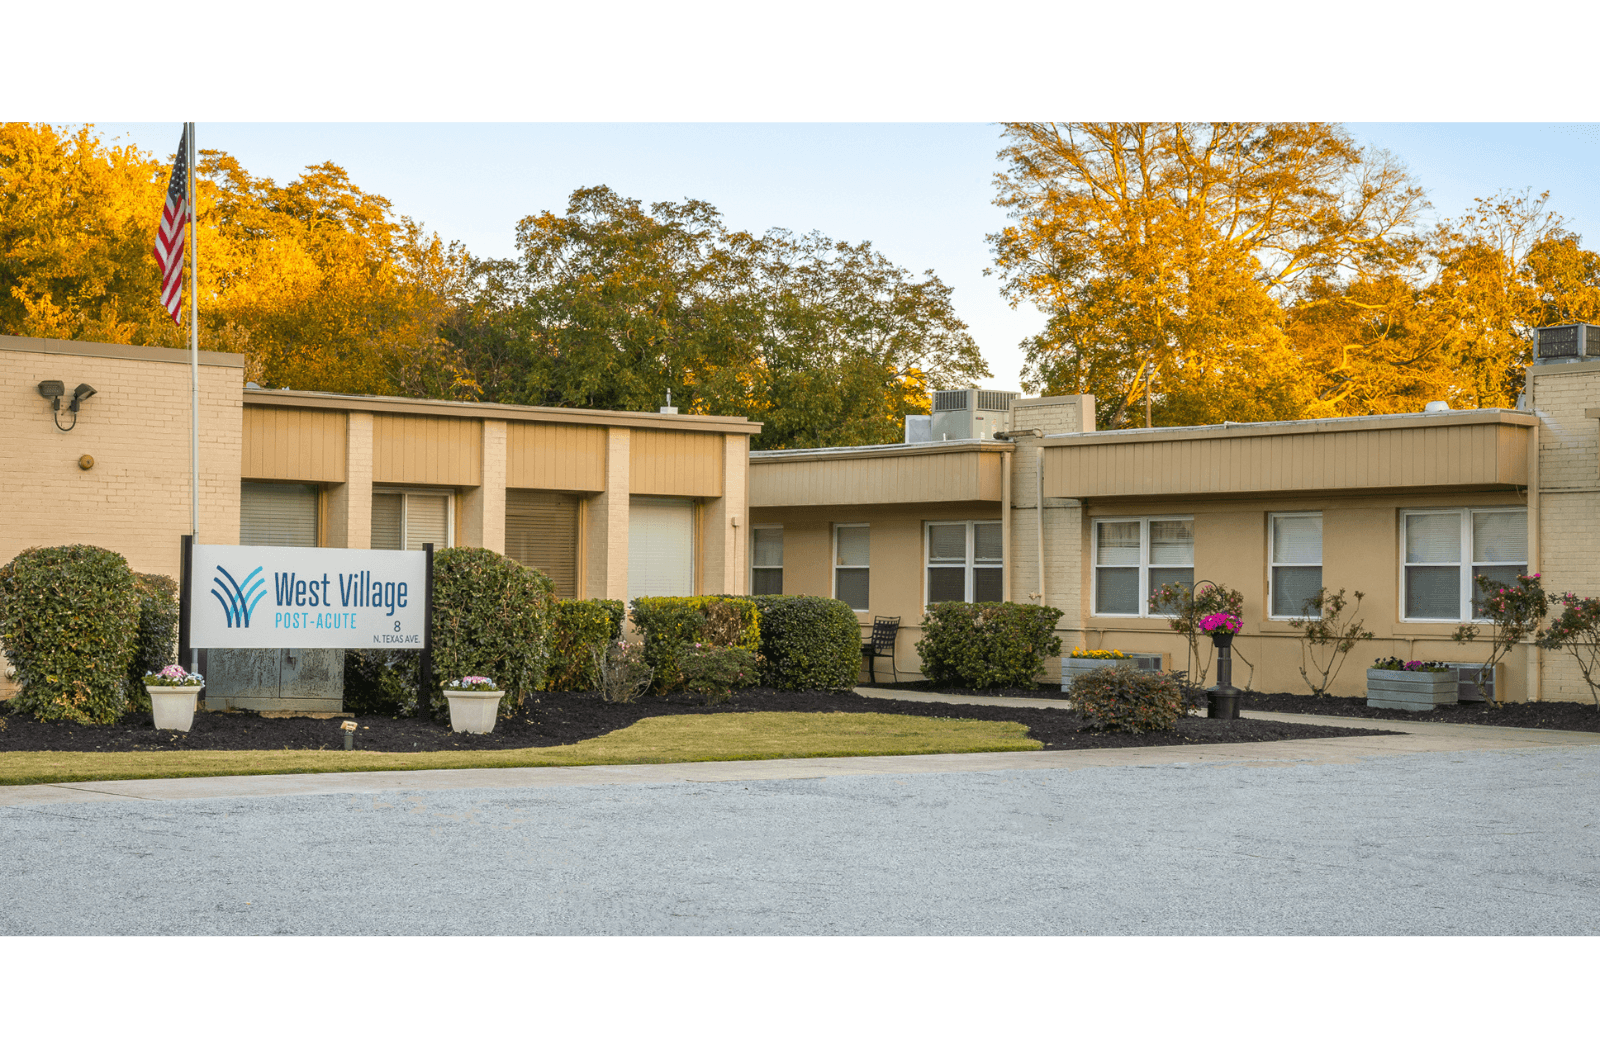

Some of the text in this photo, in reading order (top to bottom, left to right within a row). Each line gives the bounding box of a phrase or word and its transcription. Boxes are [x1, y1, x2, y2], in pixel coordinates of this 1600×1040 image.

[275, 570, 407, 616] West Village
[275, 612, 357, 630] POST-ACUTE
[393, 620, 401, 632] 8
[373, 634, 421, 643] N. TEXAS AVE.
